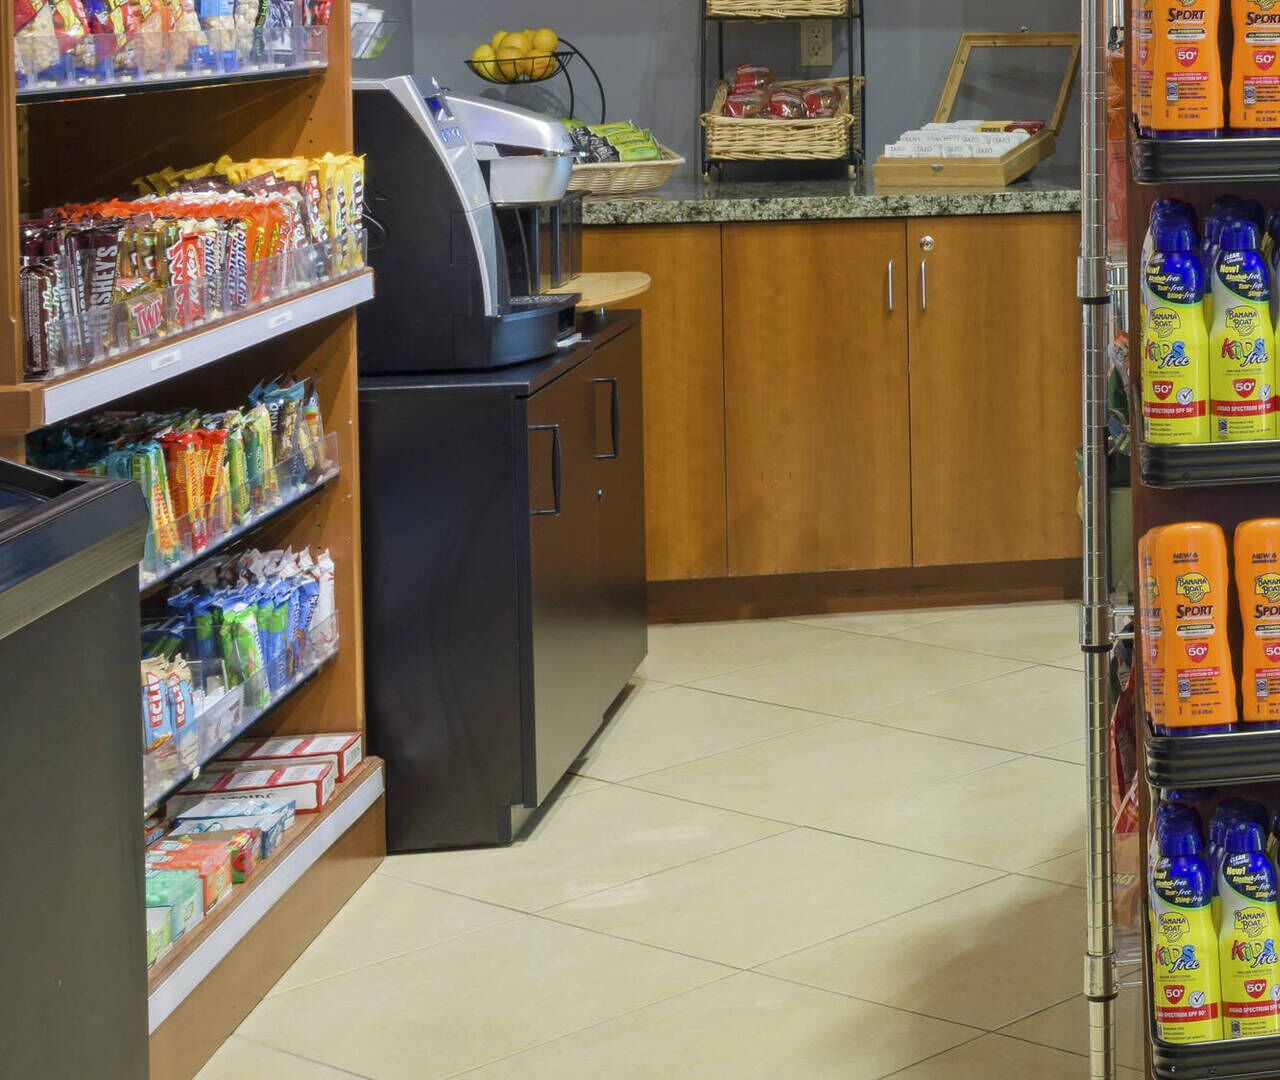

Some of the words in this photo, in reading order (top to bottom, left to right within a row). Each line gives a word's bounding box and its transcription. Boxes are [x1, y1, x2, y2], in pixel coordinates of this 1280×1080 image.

[1168, 7, 1206, 22] SPORT
[133, 299, 164, 336] TWIX
[1240, 353, 1268, 368] free
